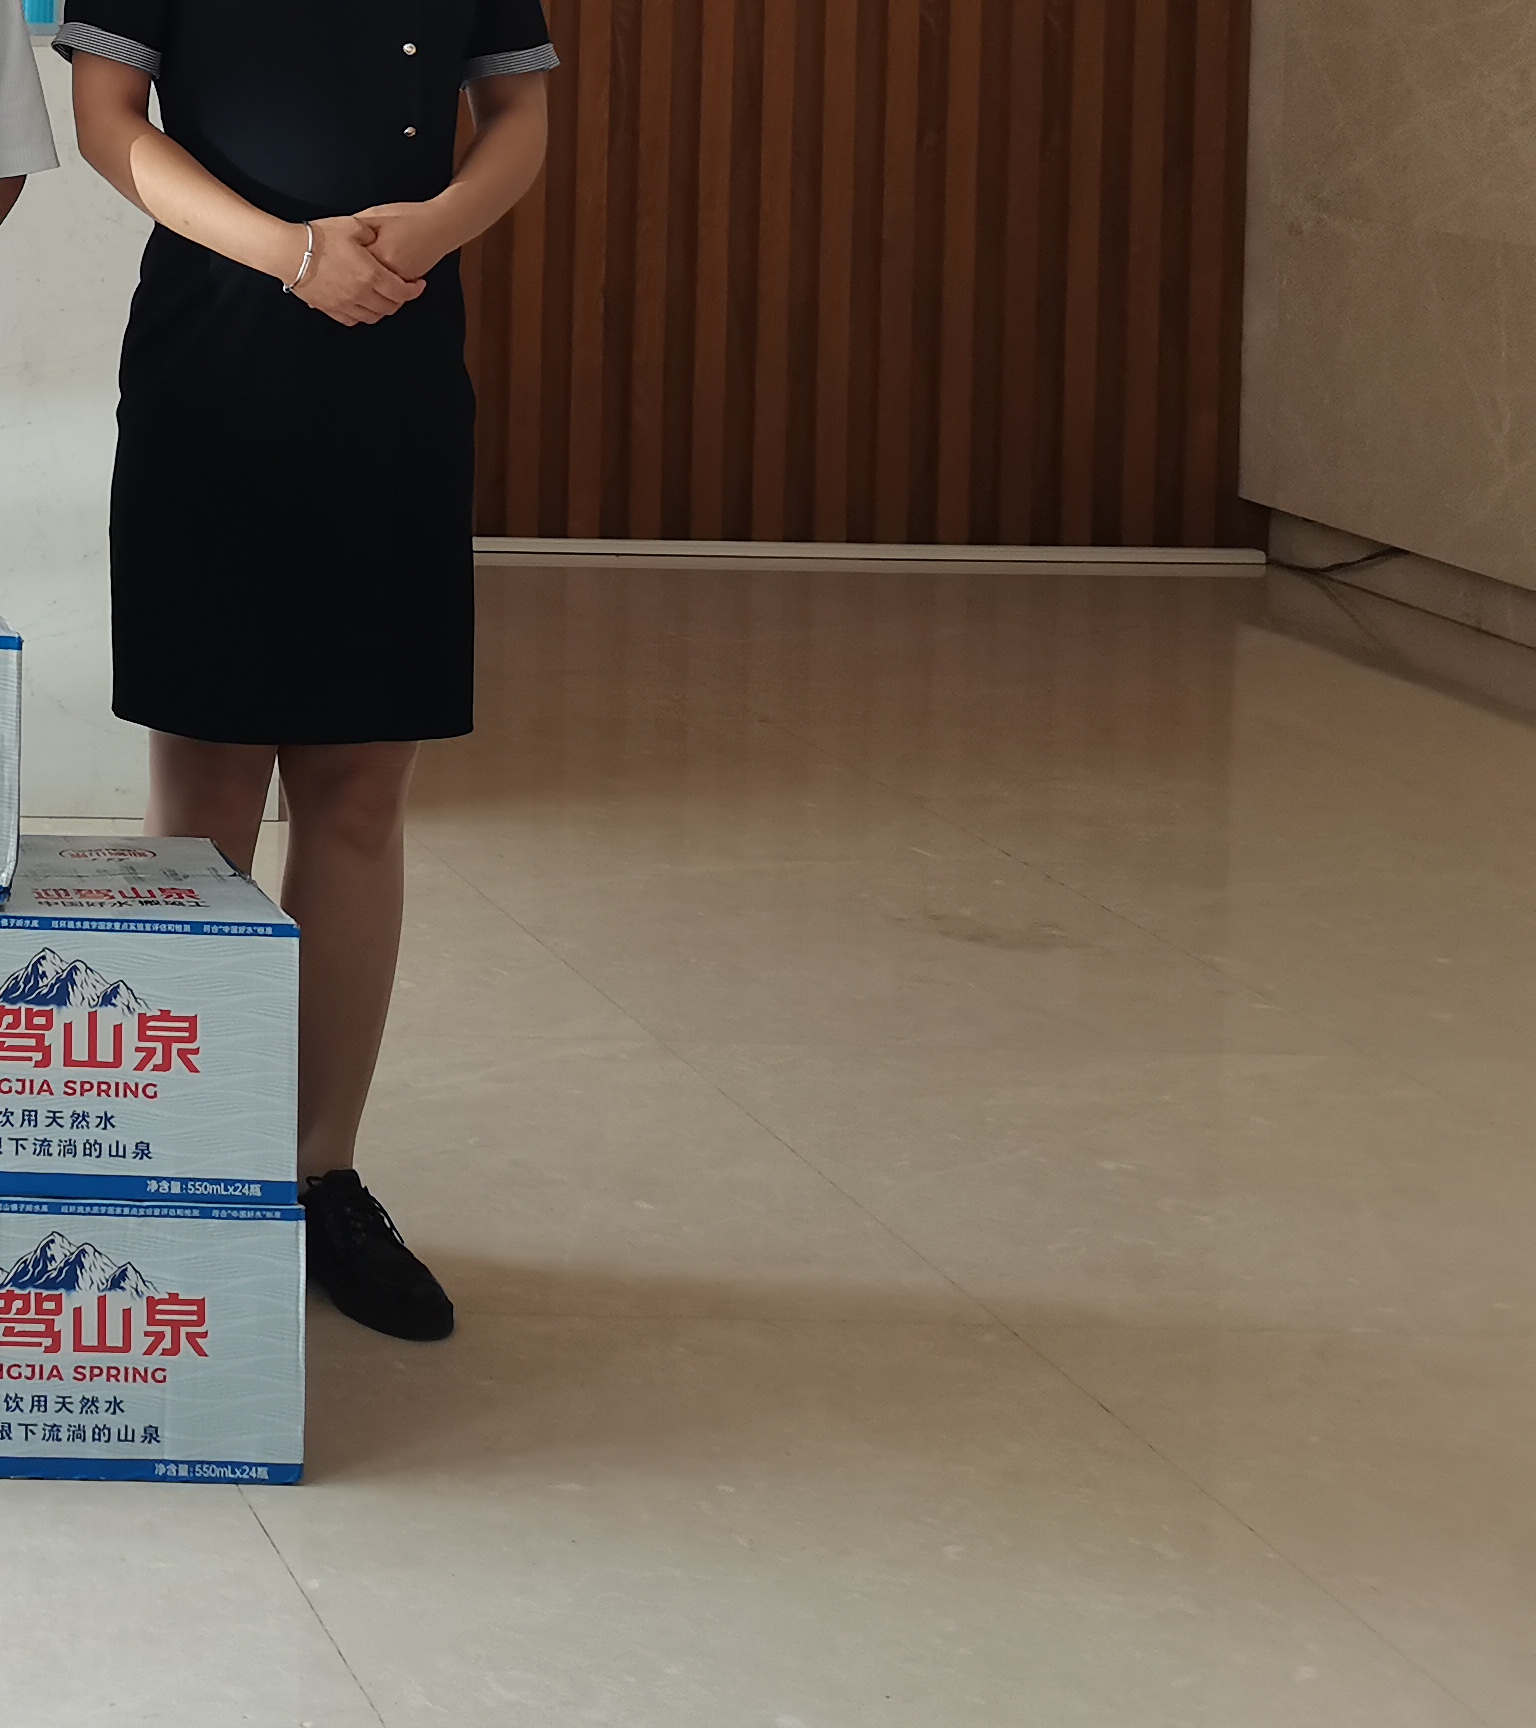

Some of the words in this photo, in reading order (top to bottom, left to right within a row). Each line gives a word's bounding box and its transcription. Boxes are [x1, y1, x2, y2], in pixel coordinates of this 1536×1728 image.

[64, 1080, 157, 1099] SPRING
[74, 1366, 166, 1383] SPRING
[4, 1393, 125, 1415] 饮用天然水
